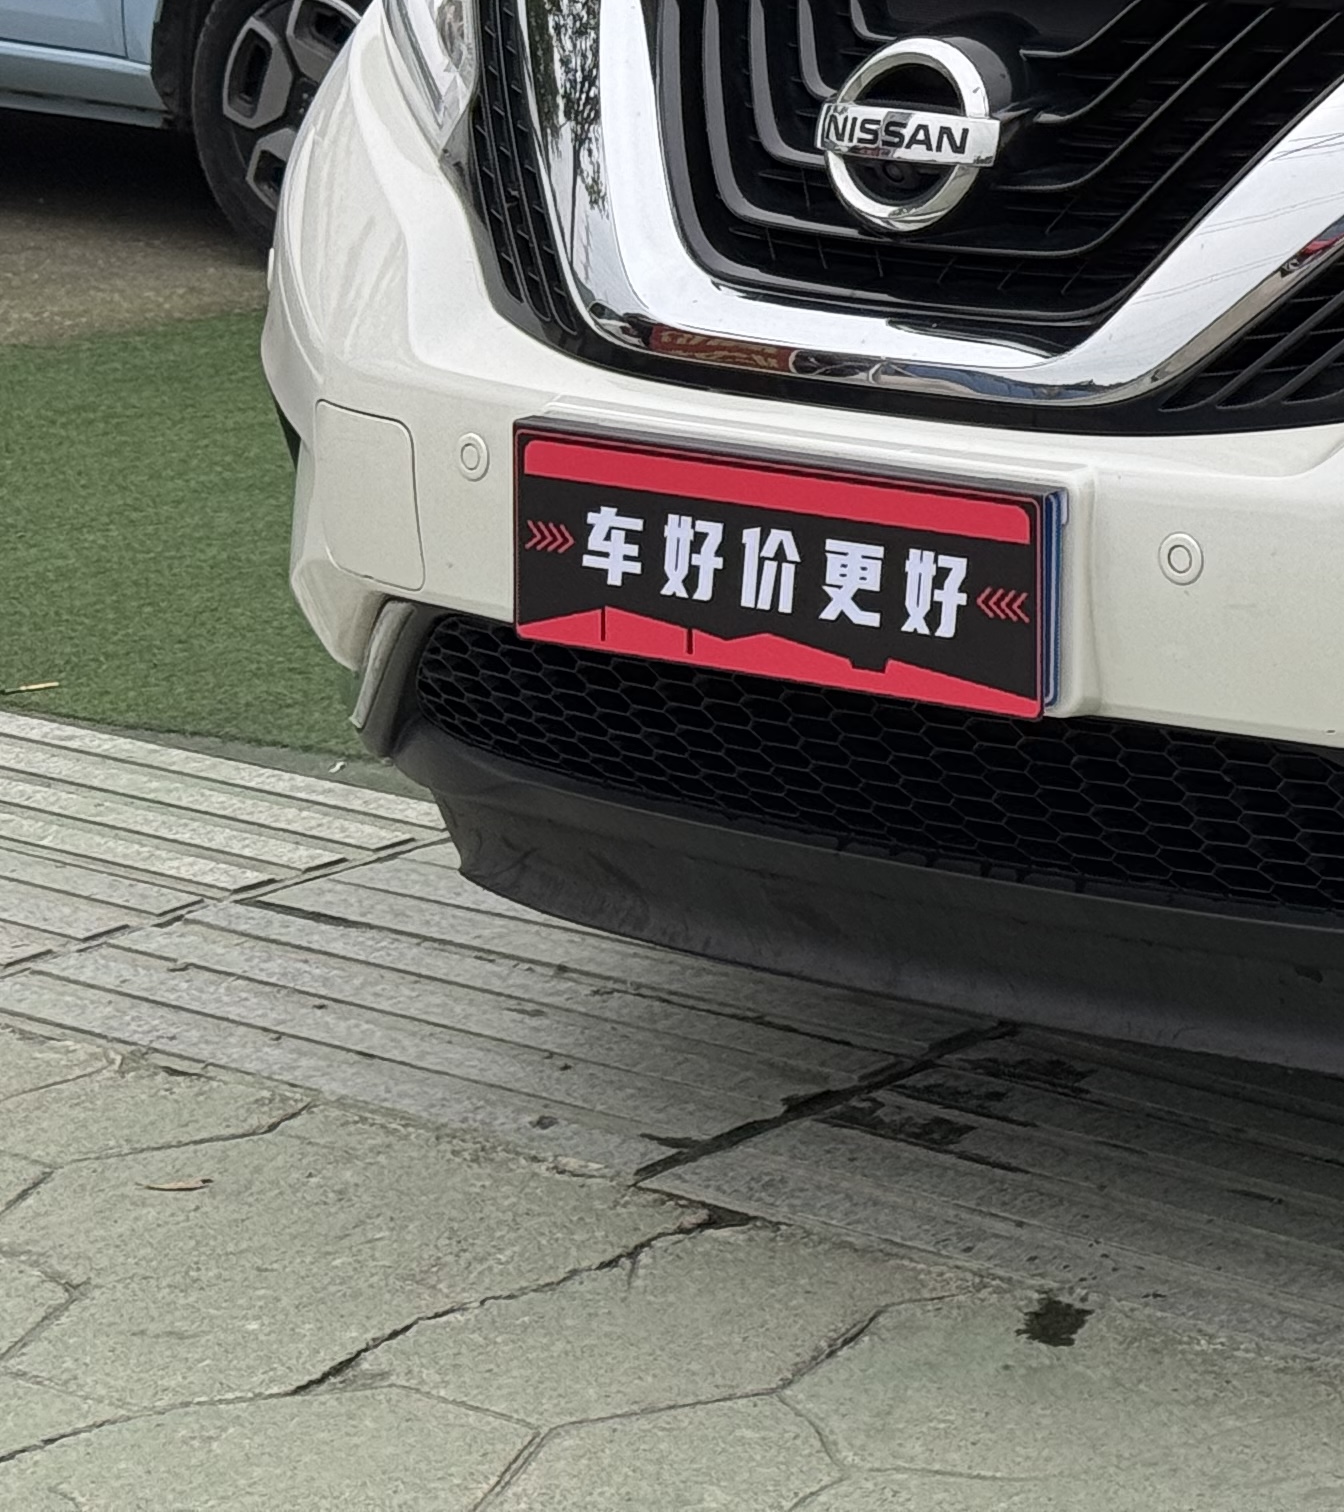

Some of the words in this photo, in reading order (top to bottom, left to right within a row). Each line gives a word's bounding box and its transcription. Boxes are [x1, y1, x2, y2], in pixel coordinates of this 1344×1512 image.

[823, 104, 969, 155] NISSAN
[581, 502, 969, 640] 车好价更好
